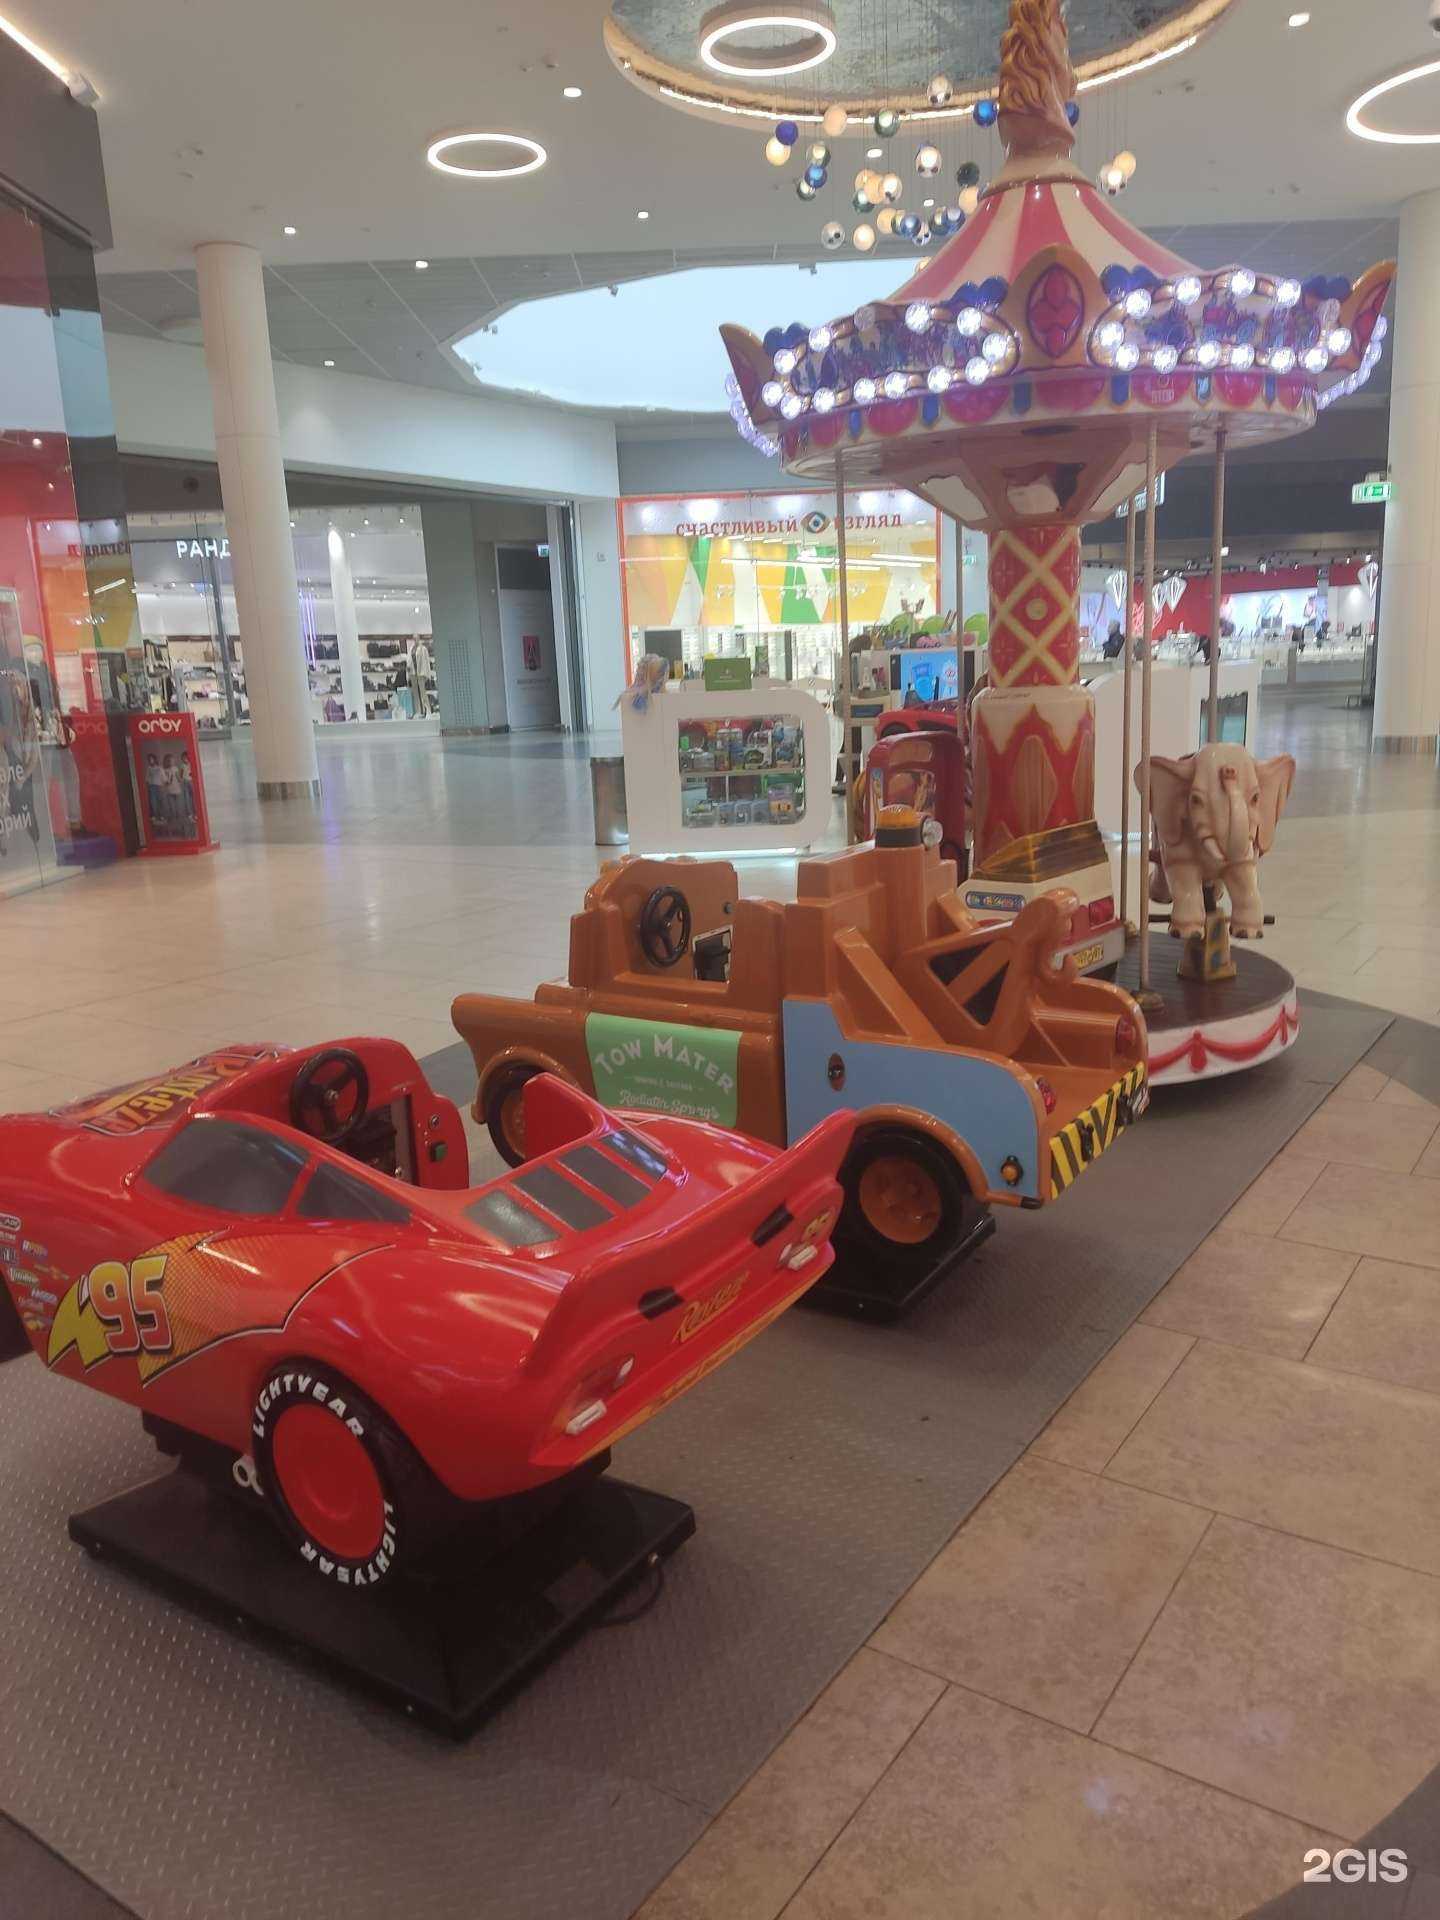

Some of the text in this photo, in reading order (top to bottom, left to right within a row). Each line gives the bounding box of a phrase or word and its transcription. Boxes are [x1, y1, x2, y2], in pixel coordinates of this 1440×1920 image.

[138, 718, 182, 733] orby
[594, 1034, 735, 1095] TOW MATER
[88, 1255, 173, 1352] 95
[253, 1374, 365, 1439] LIGHTYEAR
